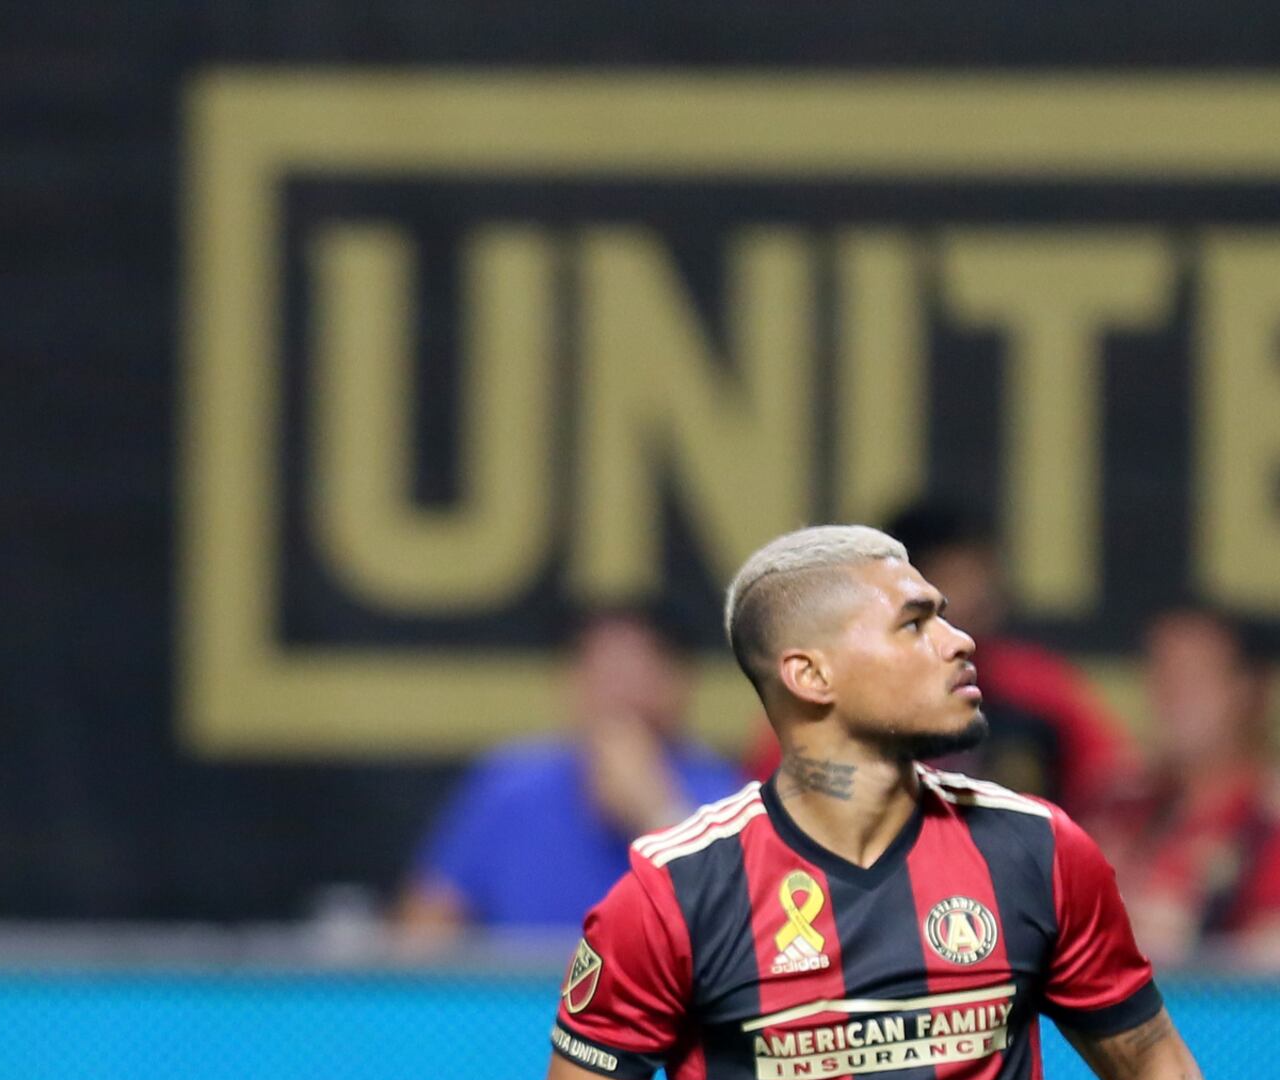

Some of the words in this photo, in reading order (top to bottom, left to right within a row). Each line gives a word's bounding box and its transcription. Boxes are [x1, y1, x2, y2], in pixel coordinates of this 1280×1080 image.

[932, 896, 981, 919] ATLANTA
[947, 911, 981, 952] A
[771, 954, 830, 974] adidas
[755, 1016, 905, 1057] AMERICAN
[917, 1003, 1013, 1038] FAMILY
[570, 1038, 618, 1071] UNITED
[777, 1039, 993, 1076] INSURANCE
